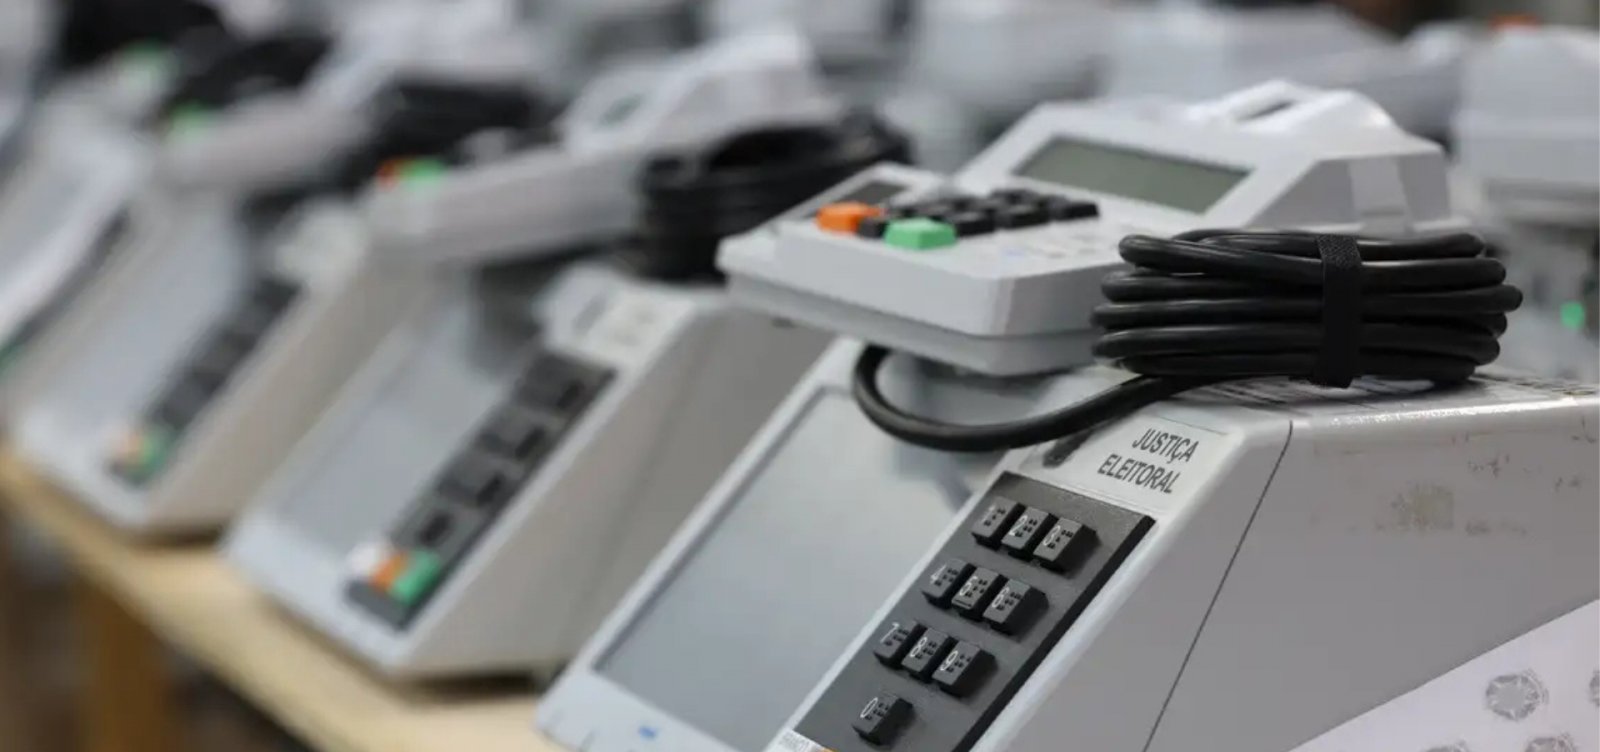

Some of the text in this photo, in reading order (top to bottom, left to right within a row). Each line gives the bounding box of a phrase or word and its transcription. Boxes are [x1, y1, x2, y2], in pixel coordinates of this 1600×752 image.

[1132, 428, 1199, 464] JUSTIÇA
[1097, 453, 1180, 494] ELEITORAL
[1008, 515, 1028, 536] 2
[1043, 525, 1061, 546] 3
[930, 563, 1010, 608] 4 5 6
[881, 622, 959, 671] 7 8 9
[860, 696, 878, 718] 0
